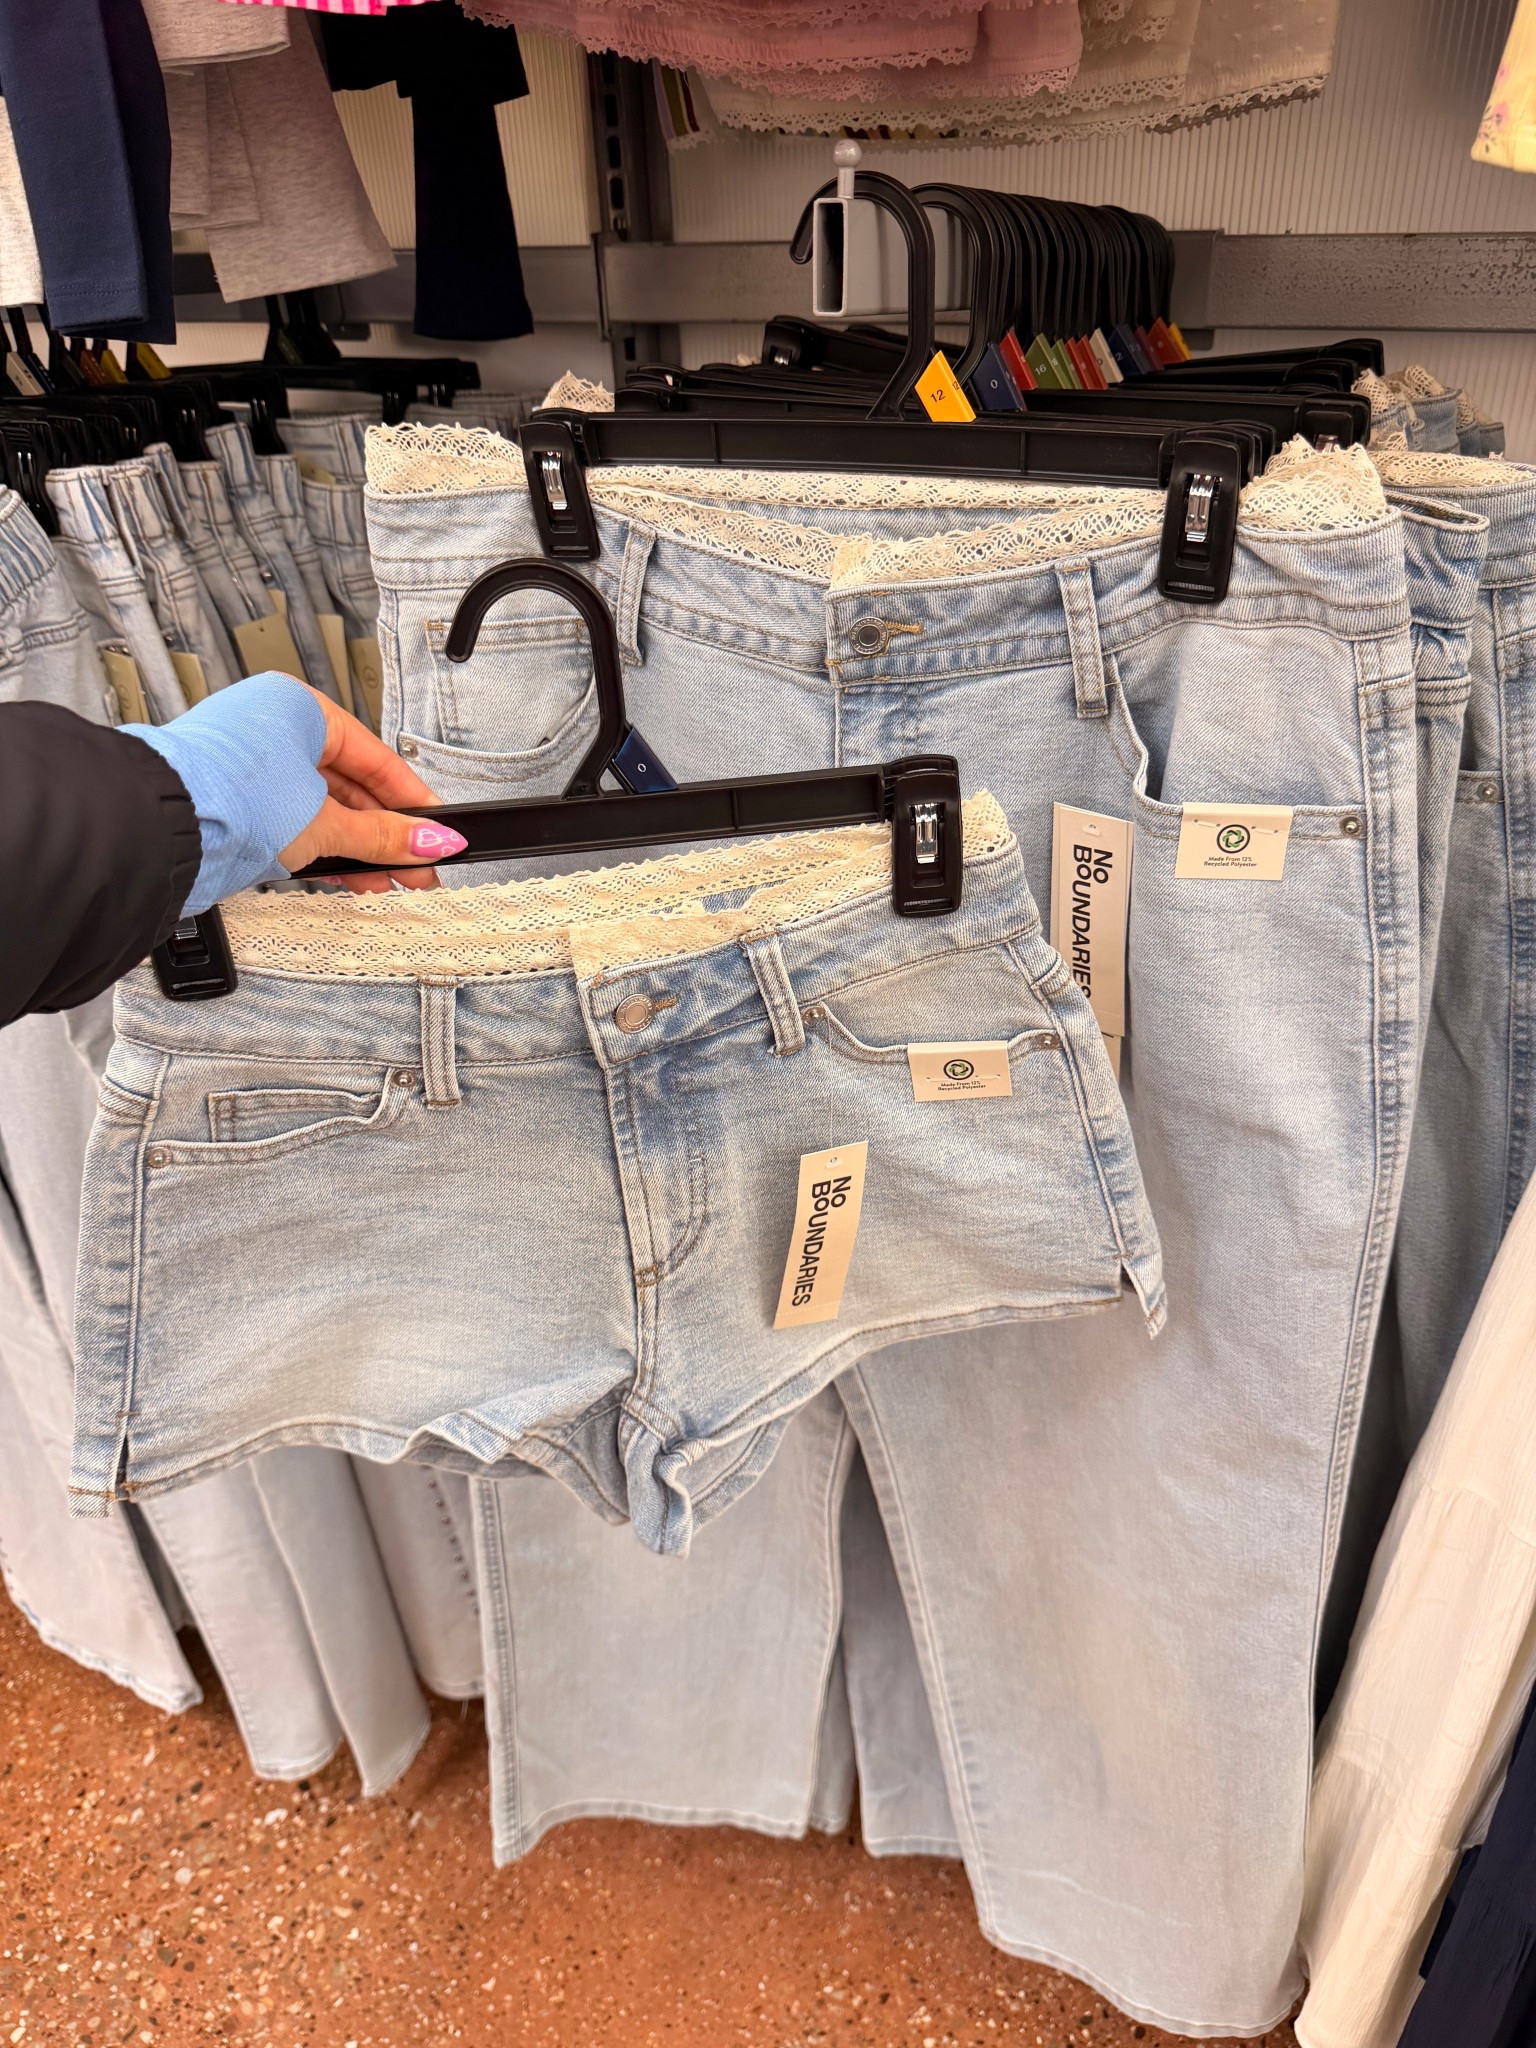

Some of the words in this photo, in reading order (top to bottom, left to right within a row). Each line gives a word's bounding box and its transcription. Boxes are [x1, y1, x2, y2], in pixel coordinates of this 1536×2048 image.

[1035, 364, 1047, 376] 16
[990, 379, 998, 389] 0
[930, 389, 946, 403] 12
[637, 763, 647, 773] 0
[1093, 849, 1113, 885] NO
[831, 1175, 852, 1208] NO
[792, 1180, 832, 1307] BOUNDARIES
